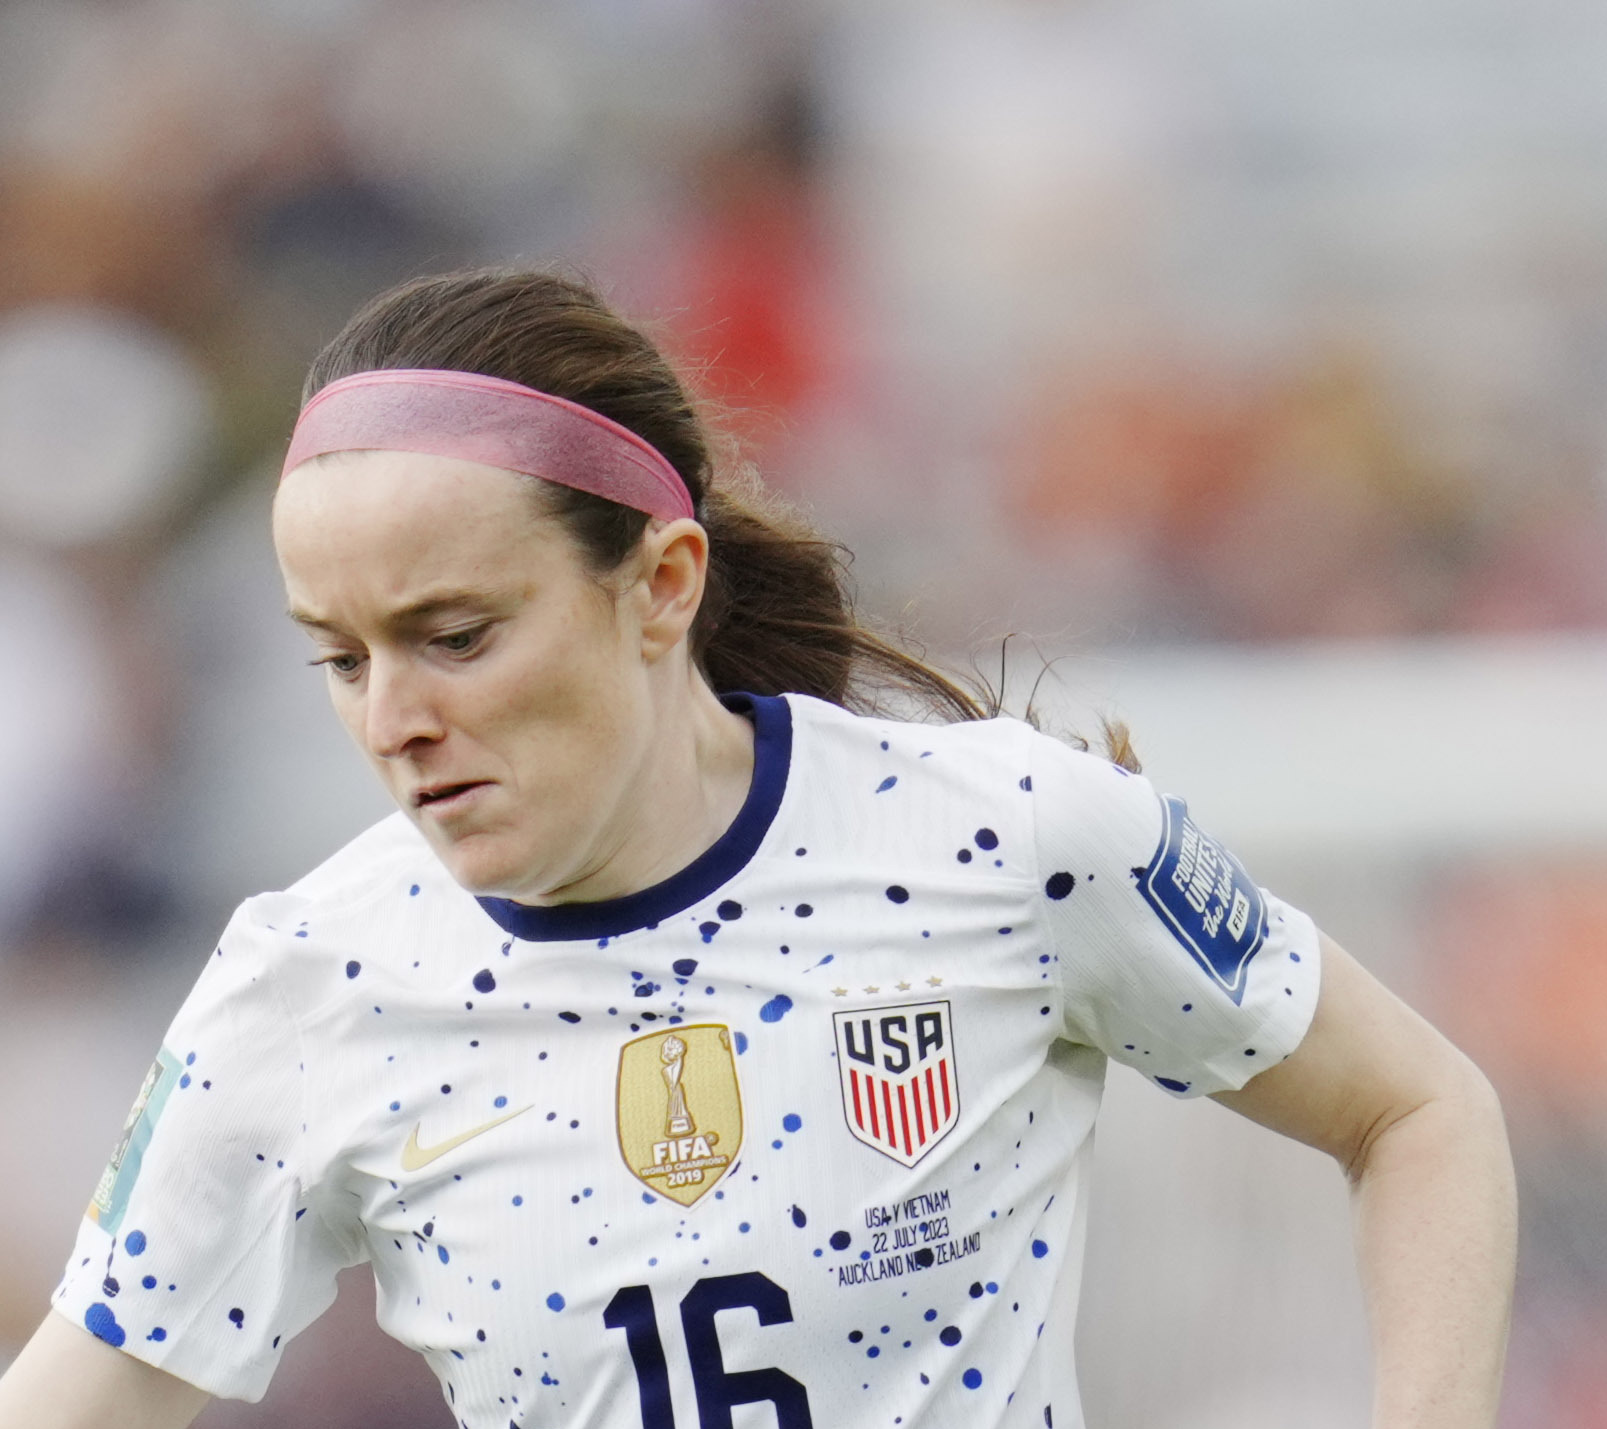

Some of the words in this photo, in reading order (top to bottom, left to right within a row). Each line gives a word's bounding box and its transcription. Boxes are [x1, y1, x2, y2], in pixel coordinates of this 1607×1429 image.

[1185, 835, 1217, 913] UNITES
[1203, 904, 1224, 938] the
[1233, 900, 1245, 931] FIFA
[845, 1012, 943, 1074] USA
[642, 1165, 672, 1176] WORLD
[674, 1156, 726, 1170] CHAMPIONS
[653, 1136, 712, 1165] FIFA
[667, 1169, 702, 1186] 2019
[865, 1207, 890, 1228] USA
[903, 1189, 951, 1219] VIETNAM
[872, 1232, 888, 1254] 22
[892, 1224, 917, 1250] JULY
[922, 1216, 950, 1243] 2023
[839, 1256, 904, 1287] AUCKLAND
[935, 1232, 981, 1266] ZEALAND
